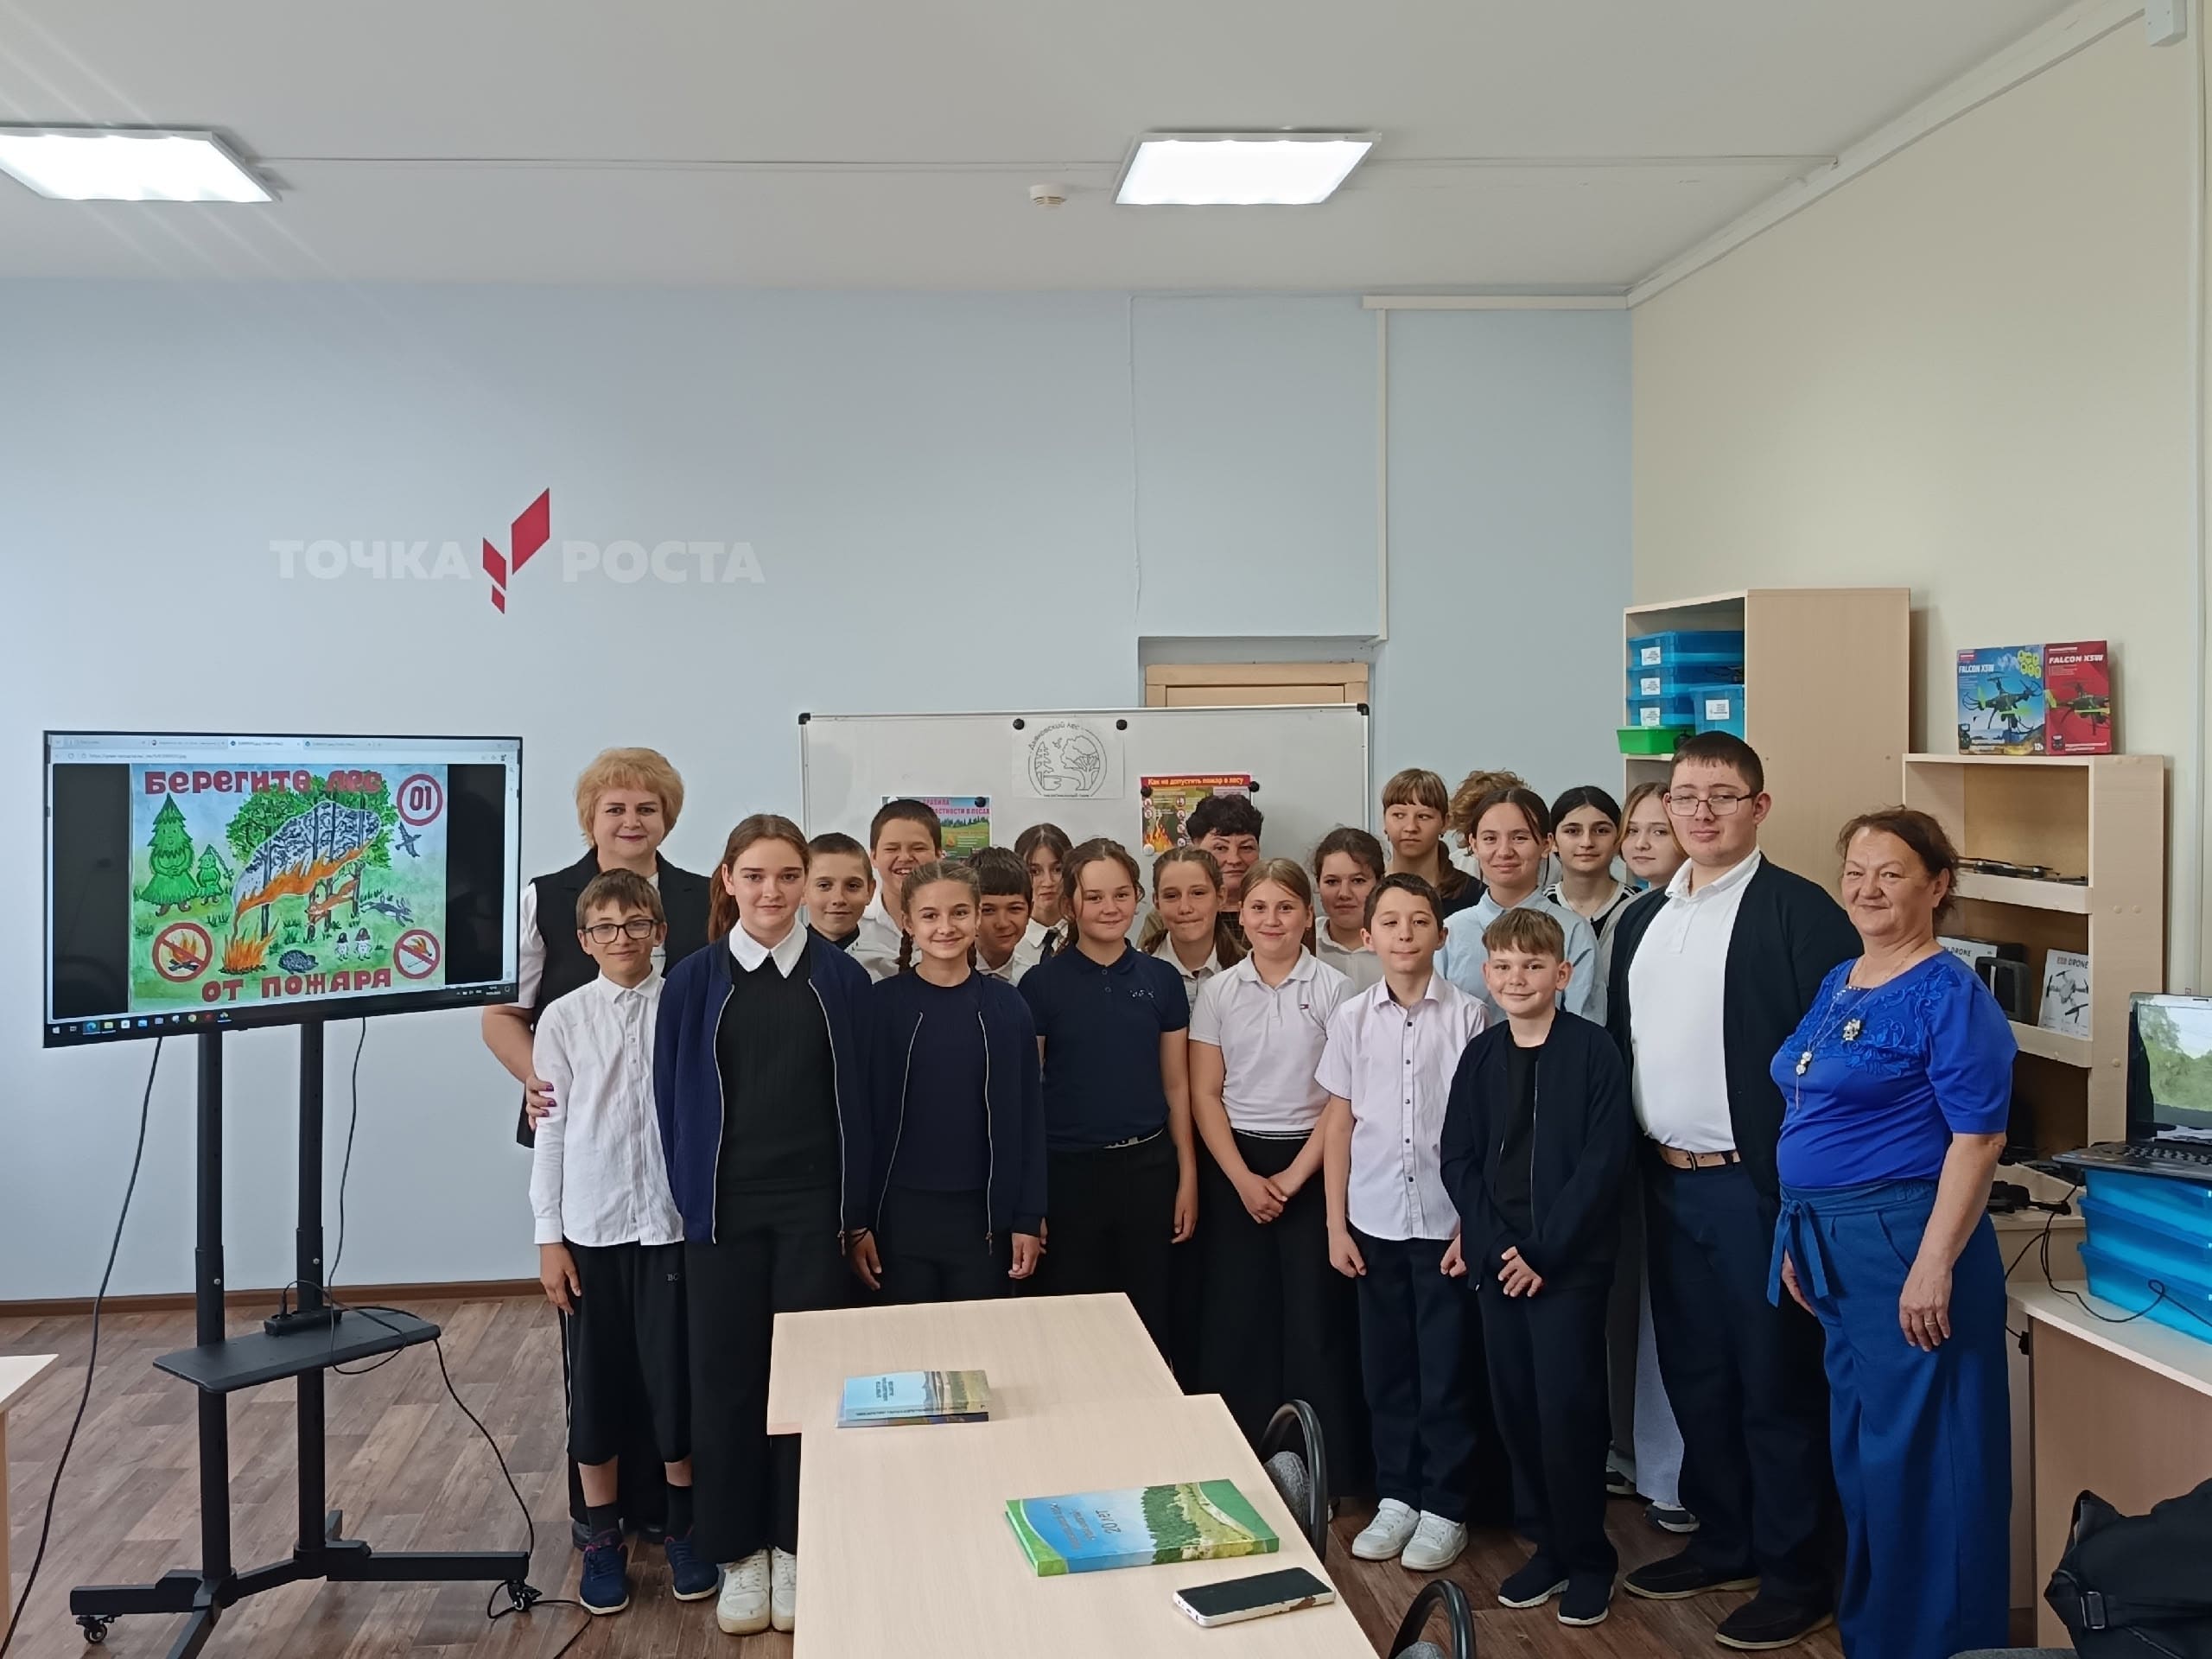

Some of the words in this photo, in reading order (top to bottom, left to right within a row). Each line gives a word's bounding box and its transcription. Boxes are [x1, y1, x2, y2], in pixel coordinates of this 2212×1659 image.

[269, 539, 473, 581] ТОЧКА
[563, 541, 766, 584] РОСТА
[1959, 664, 1980, 673] FALCON
[410, 785, 432, 811] 01
[2068, 958, 2089, 969] DRONE
[201, 979, 244, 1002] ОТ
[261, 969, 391, 998] ПОЖАРА
[1095, 1510, 1114, 1521] лет
[1101, 1522, 1122, 1534] 20
